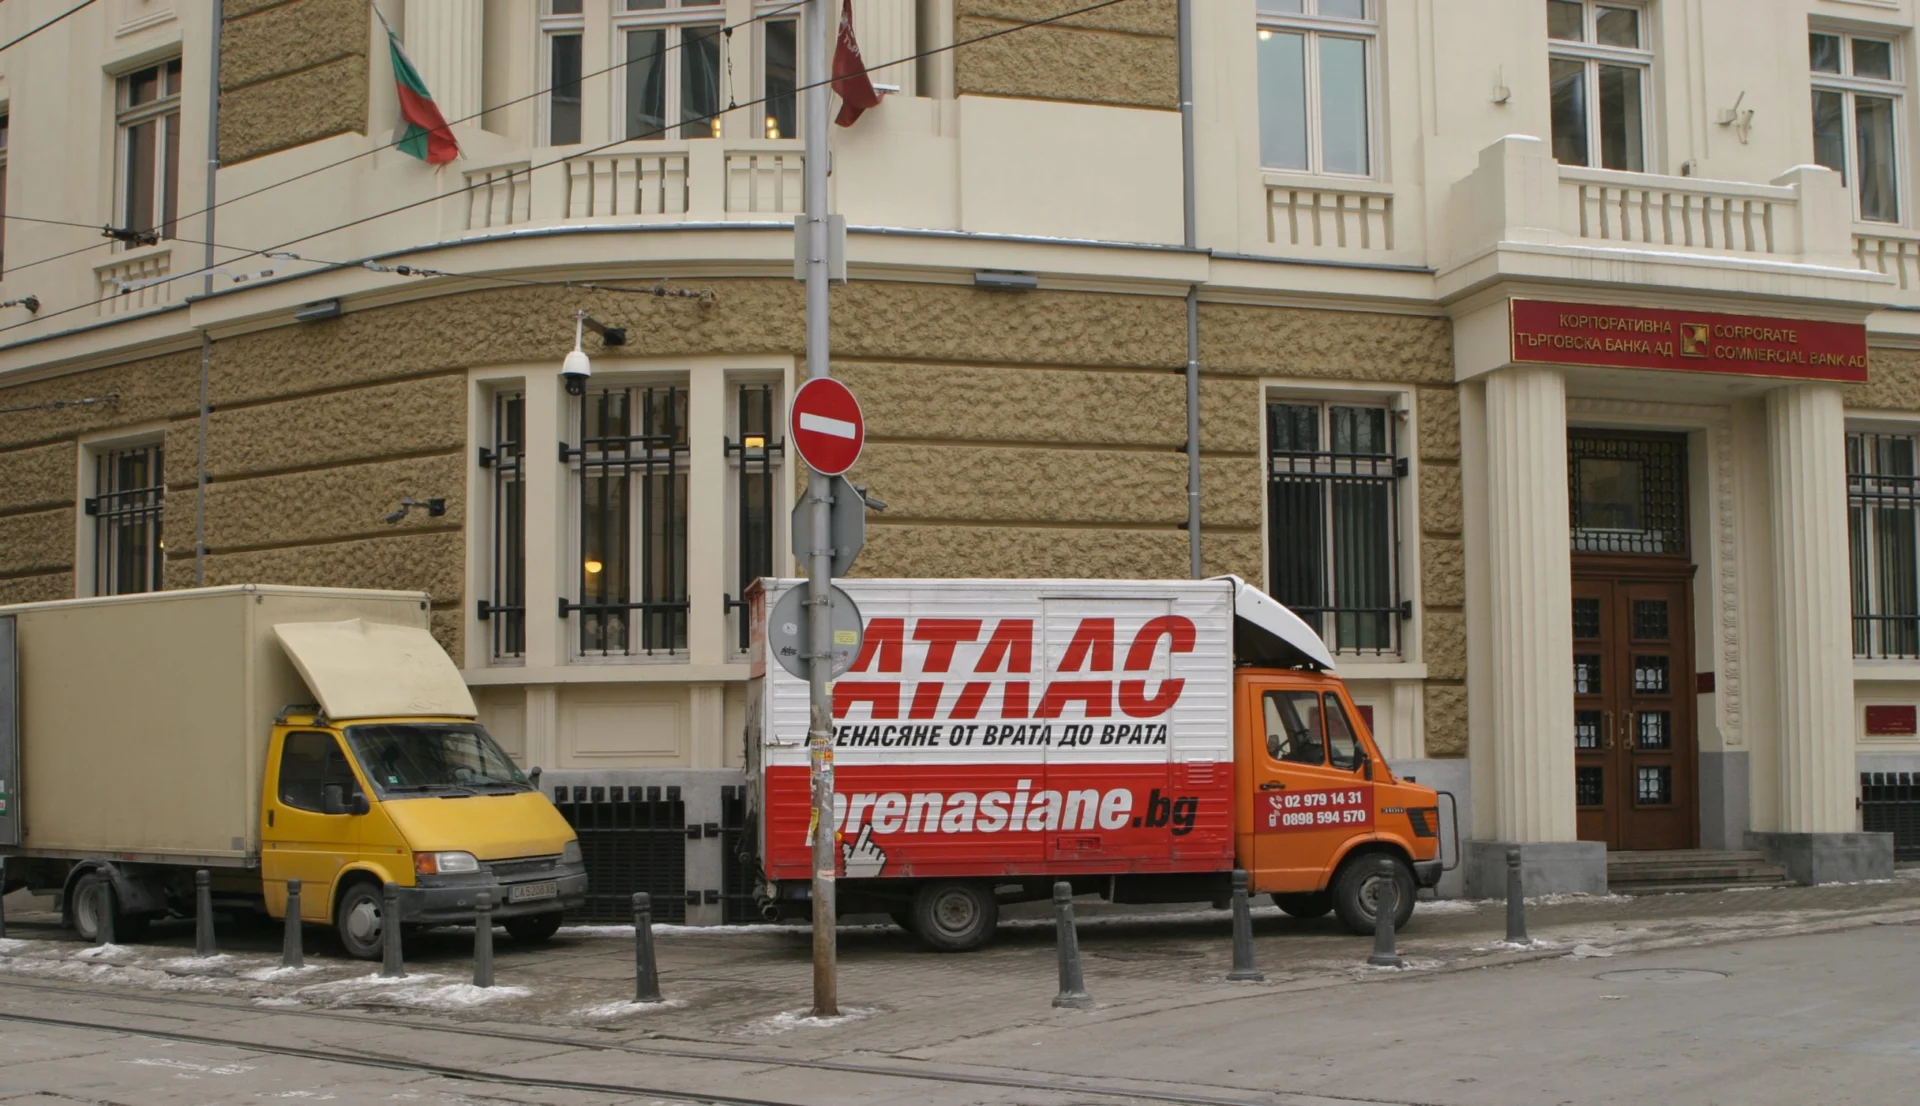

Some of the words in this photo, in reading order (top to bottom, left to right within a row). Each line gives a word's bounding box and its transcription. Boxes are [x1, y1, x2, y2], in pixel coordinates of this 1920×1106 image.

[1559, 314, 1673, 334] КОРПОРАТИВНА
[1714, 324, 1798, 343] CORPORATE
[1517, 332, 1601, 351] ТЪРГОВСКА
[1605, 338, 1650, 354] БАНКА
[1654, 342, 1674, 357] АД
[1714, 345, 1806, 364] COMMERCIAL
[1809, 351, 1845, 366] BANK
[1848, 354, 1866, 368] AD
[831, 614, 1196, 719] АТЛАС
[804, 725, 943, 748] ЕНАСЯНЕ
[950, 725, 975, 747] ОТ
[982, 724, 1051, 747] ВРАТА
[1057, 724, 1093, 748] ДО
[1100, 723, 1167, 746] ВРАТА
[1284, 795, 1301, 808] 02
[1304, 793, 1327, 807] 979
[1330, 792, 1345, 805] 14
[1348, 791, 1362, 804] 31
[1282, 812, 1314, 826] 0898
[1317, 810, 1340, 824] 594
[1343, 809, 1366, 823] 570
